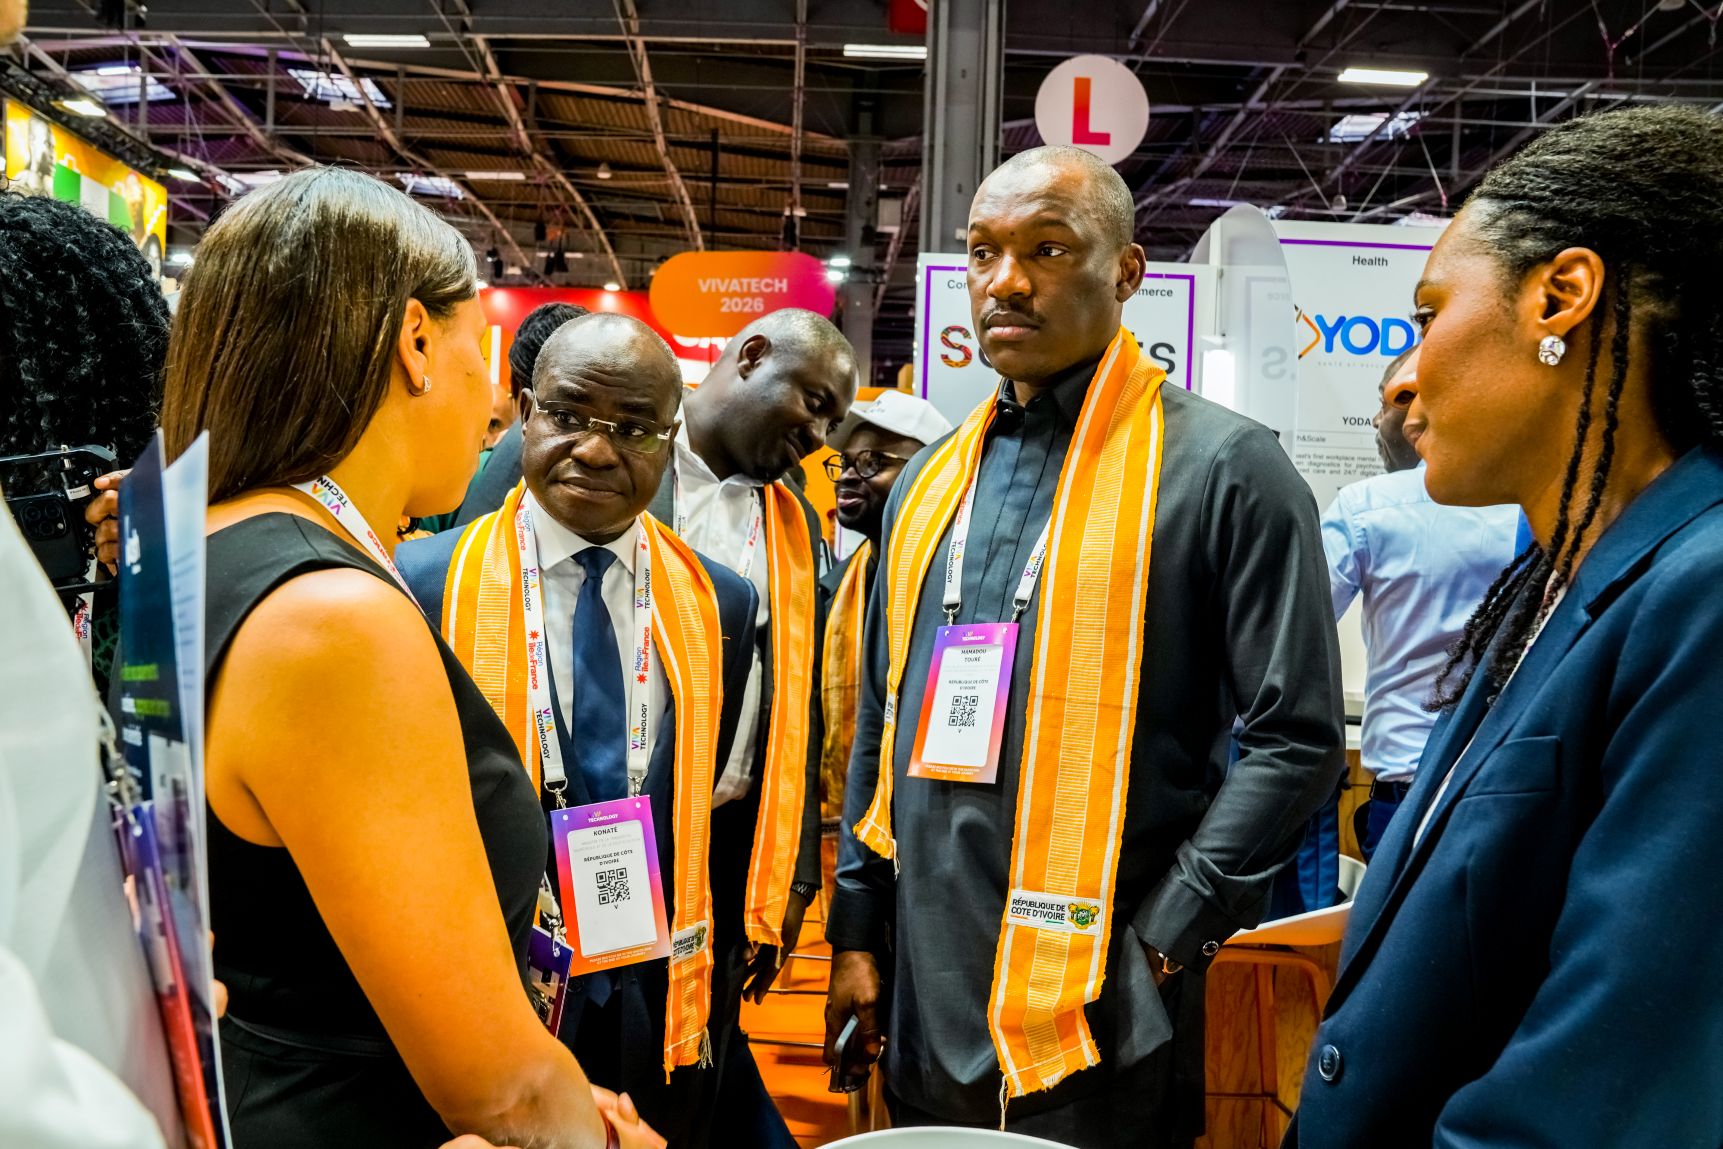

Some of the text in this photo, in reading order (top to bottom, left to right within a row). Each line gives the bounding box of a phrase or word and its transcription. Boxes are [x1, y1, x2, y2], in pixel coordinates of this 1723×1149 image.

[1072, 77, 1111, 146] L
[1352, 255, 1389, 267] Health
[698, 278, 788, 293] VIVATECH
[720, 297, 764, 313] 2026
[1314, 314, 1422, 357] YOD
[1342, 416, 1372, 426] YODA
[310, 482, 342, 516] VIVA
[946, 541, 957, 584] TECHNOLOGY
[528, 567, 538, 589] VIVA
[522, 567, 532, 612] TECHNOLOGY
[636, 588, 645, 609] VIVA
[535, 640, 544, 667] Région
[542, 707, 554, 733] VIVA
[640, 703, 648, 751] TECHNOLOGY
[535, 708, 551, 759] TECHNOLOGY
[631, 727, 640, 750] VIVA
[588, 813, 619, 823] TECHNOLOGY
[593, 826, 618, 837] KONATÉ
[583, 852, 613, 863] RÉPUBLIQUE
[620, 848, 633, 857] CÔTE
[1012, 897, 1066, 912] RÉPUBLIQUE DE
[1032, 910, 1066, 921] D'IVOIRE
